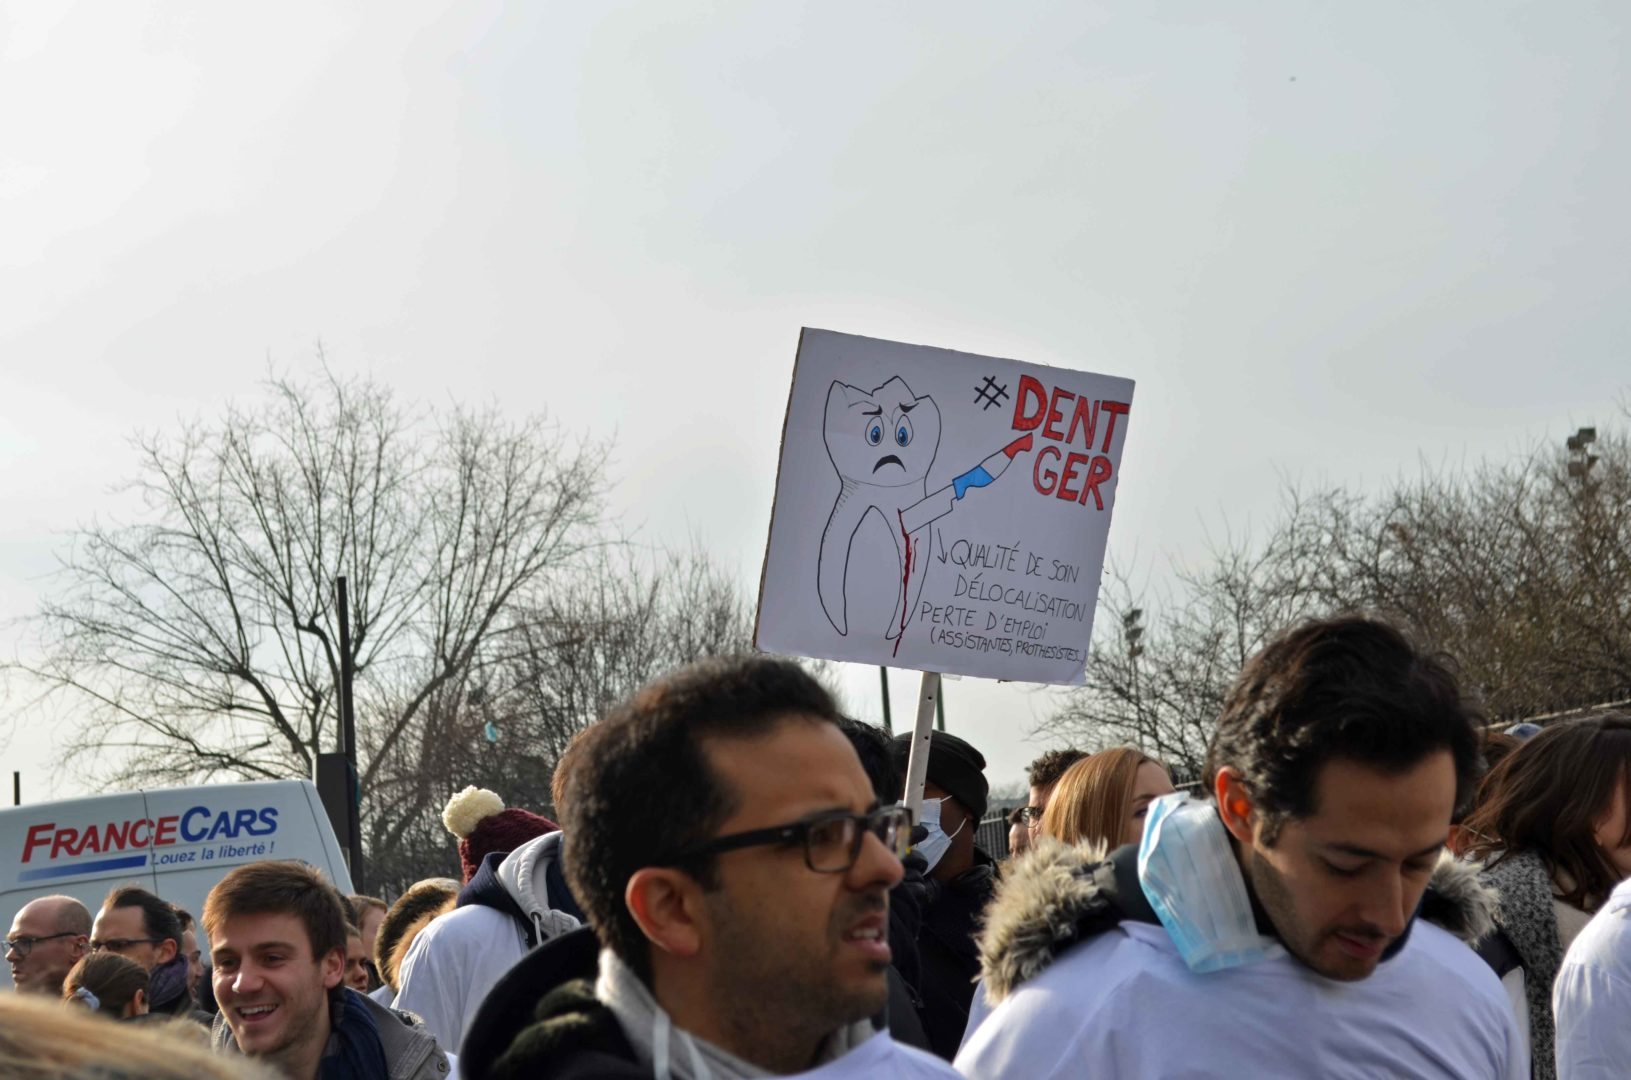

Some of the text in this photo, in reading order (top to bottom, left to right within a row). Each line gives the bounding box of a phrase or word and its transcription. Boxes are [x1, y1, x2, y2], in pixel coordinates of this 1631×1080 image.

[1032, 445, 1113, 511] GER
[1025, 551, 1044, 577] DE
[920, 600, 977, 627] PERTE
[151, 851, 196, 866] Louez
[201, 847, 215, 861] la
[218, 841, 266, 859] liberté
